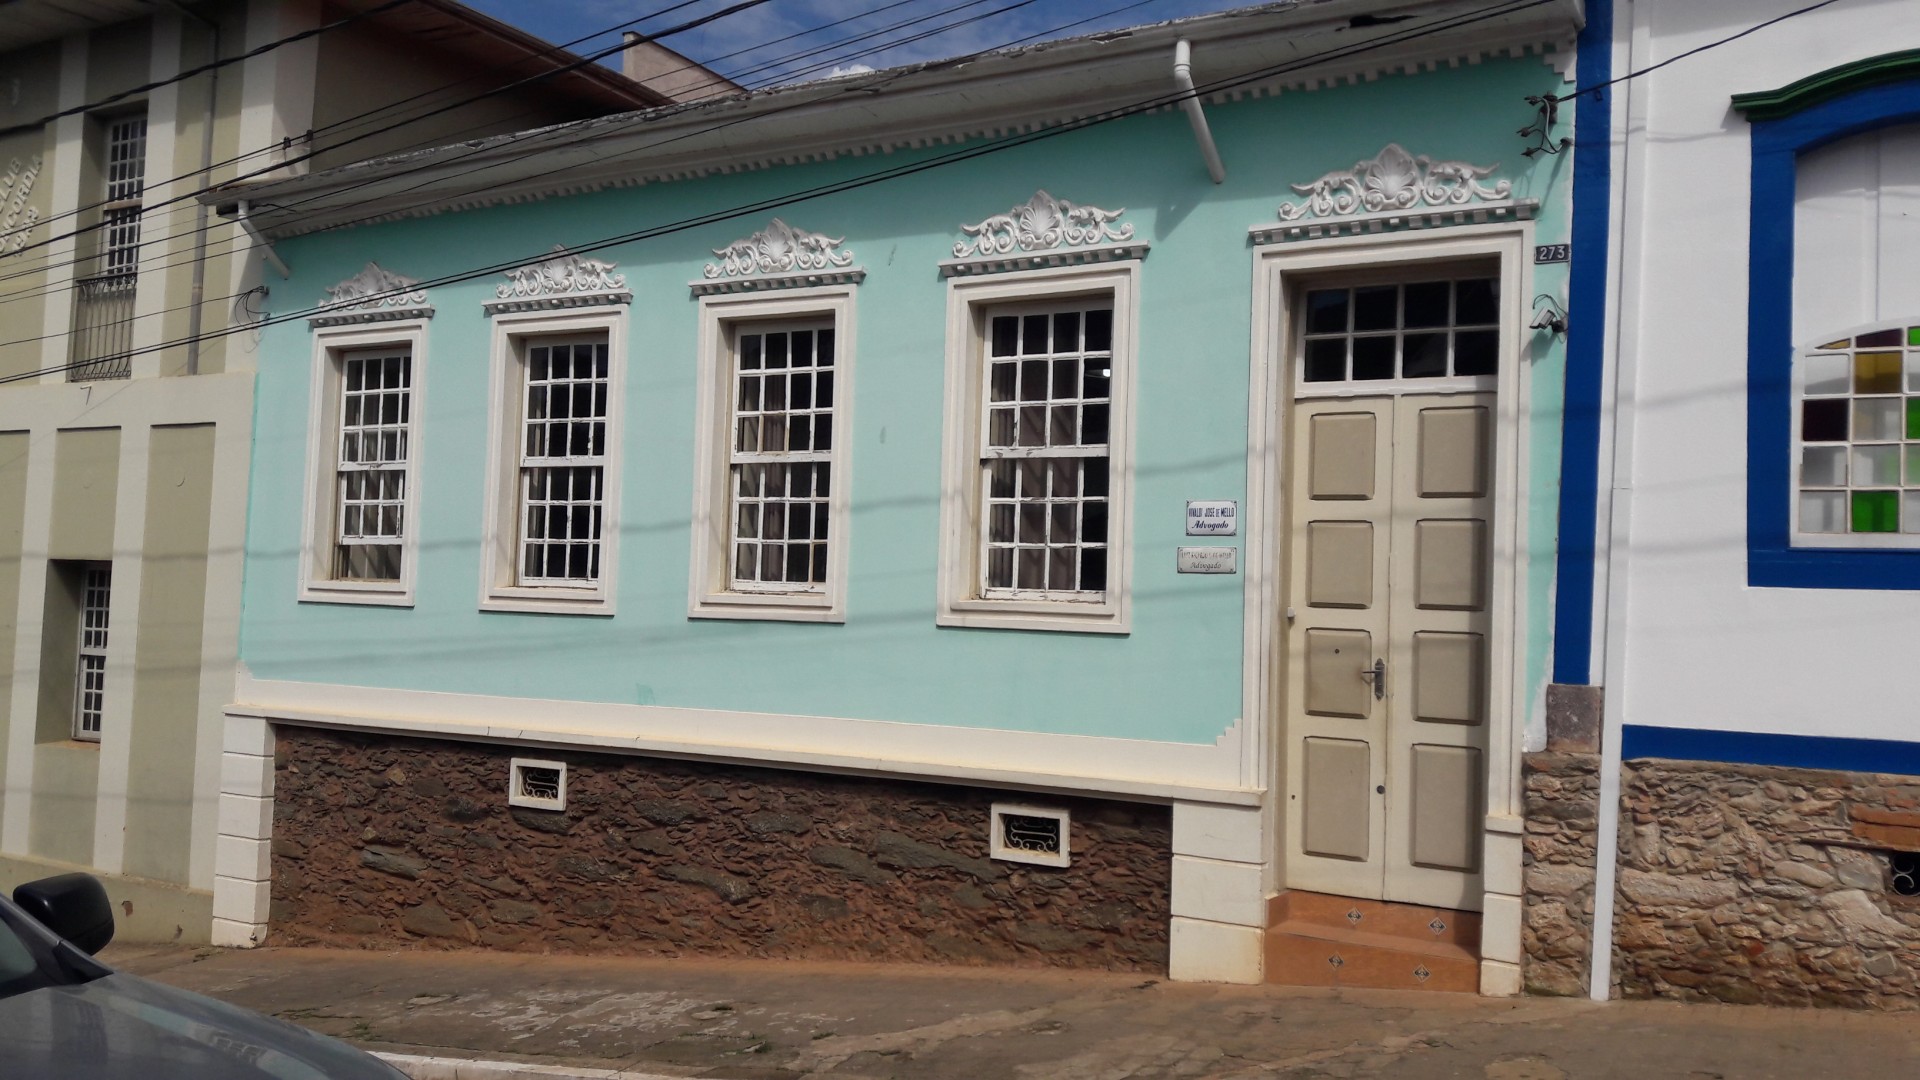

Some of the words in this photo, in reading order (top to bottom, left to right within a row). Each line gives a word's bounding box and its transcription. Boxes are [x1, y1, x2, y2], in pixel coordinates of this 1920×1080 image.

[1539, 245, 1565, 260] 273
[1221, 507, 1234, 517] MELLO
[1191, 520, 1229, 531] Advogado
[1190, 562, 1222, 571] Advogado
